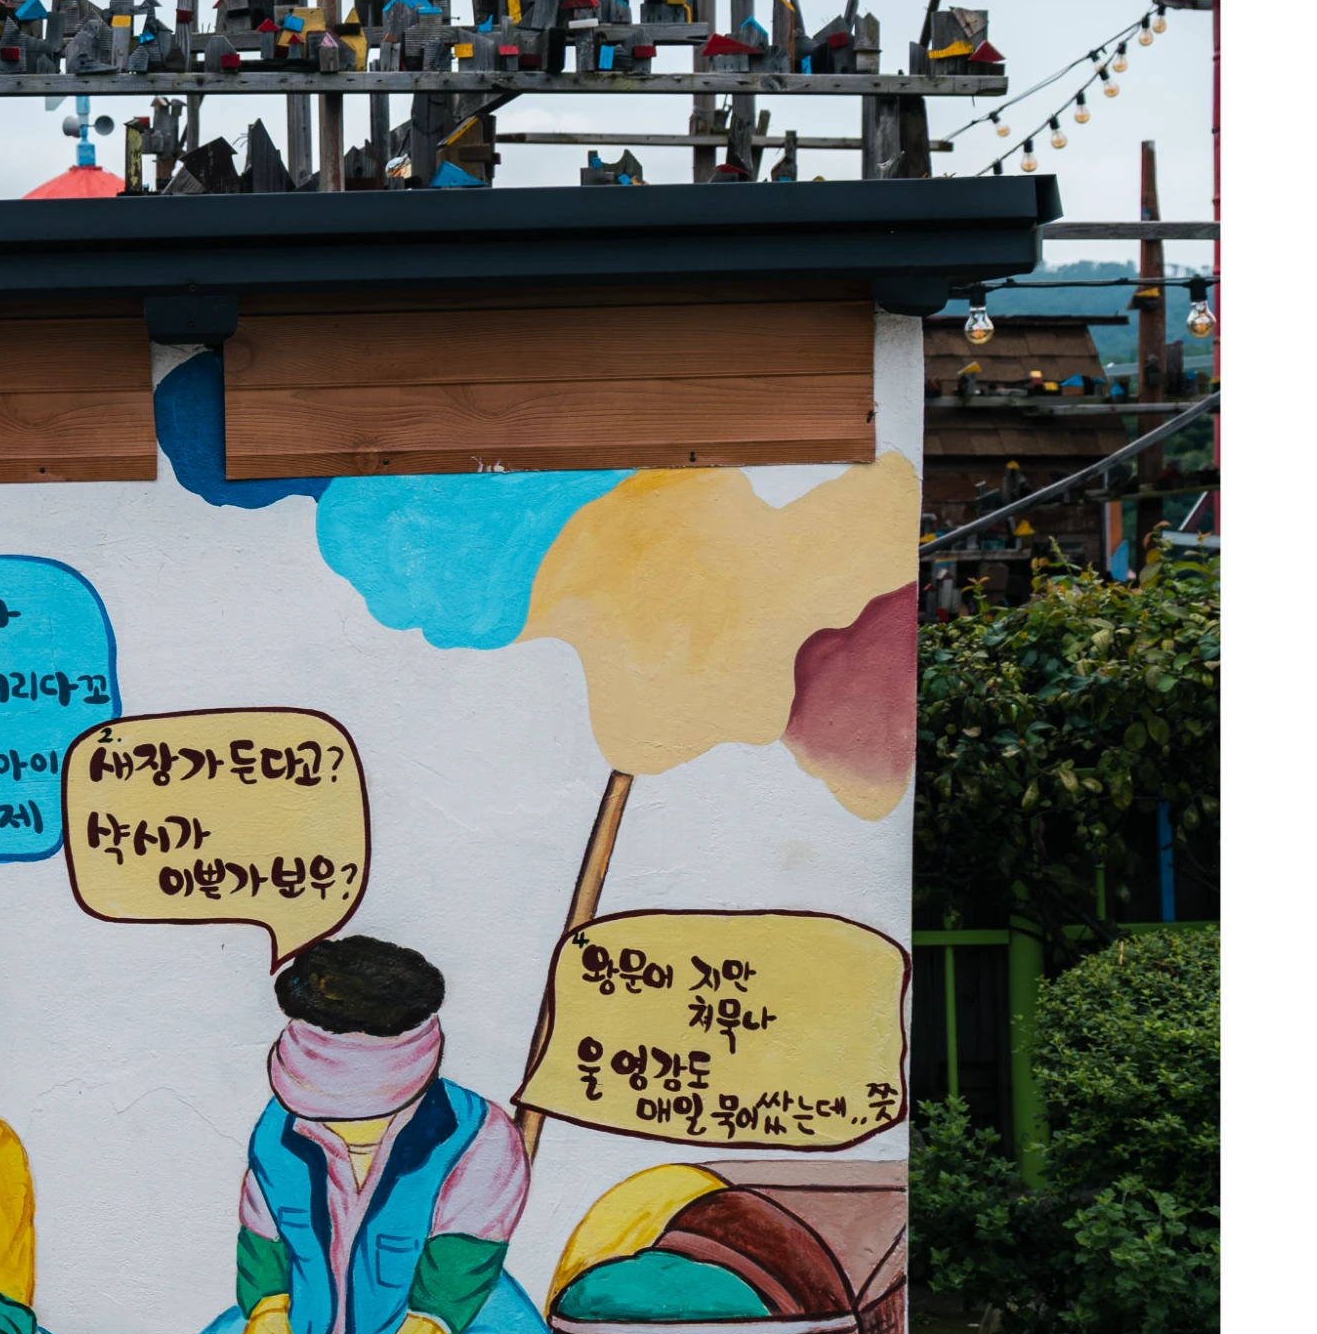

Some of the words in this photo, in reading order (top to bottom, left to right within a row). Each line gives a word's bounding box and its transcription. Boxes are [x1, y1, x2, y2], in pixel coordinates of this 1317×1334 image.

[89, 741, 225, 786] 새장가
[581, 943, 673, 995] 왕문어
[689, 956, 756, 992] 지만
[578, 1037, 603, 1100] 울
[611, 1045, 710, 1092] 영감도
[636, 1093, 707, 1136] 매일
